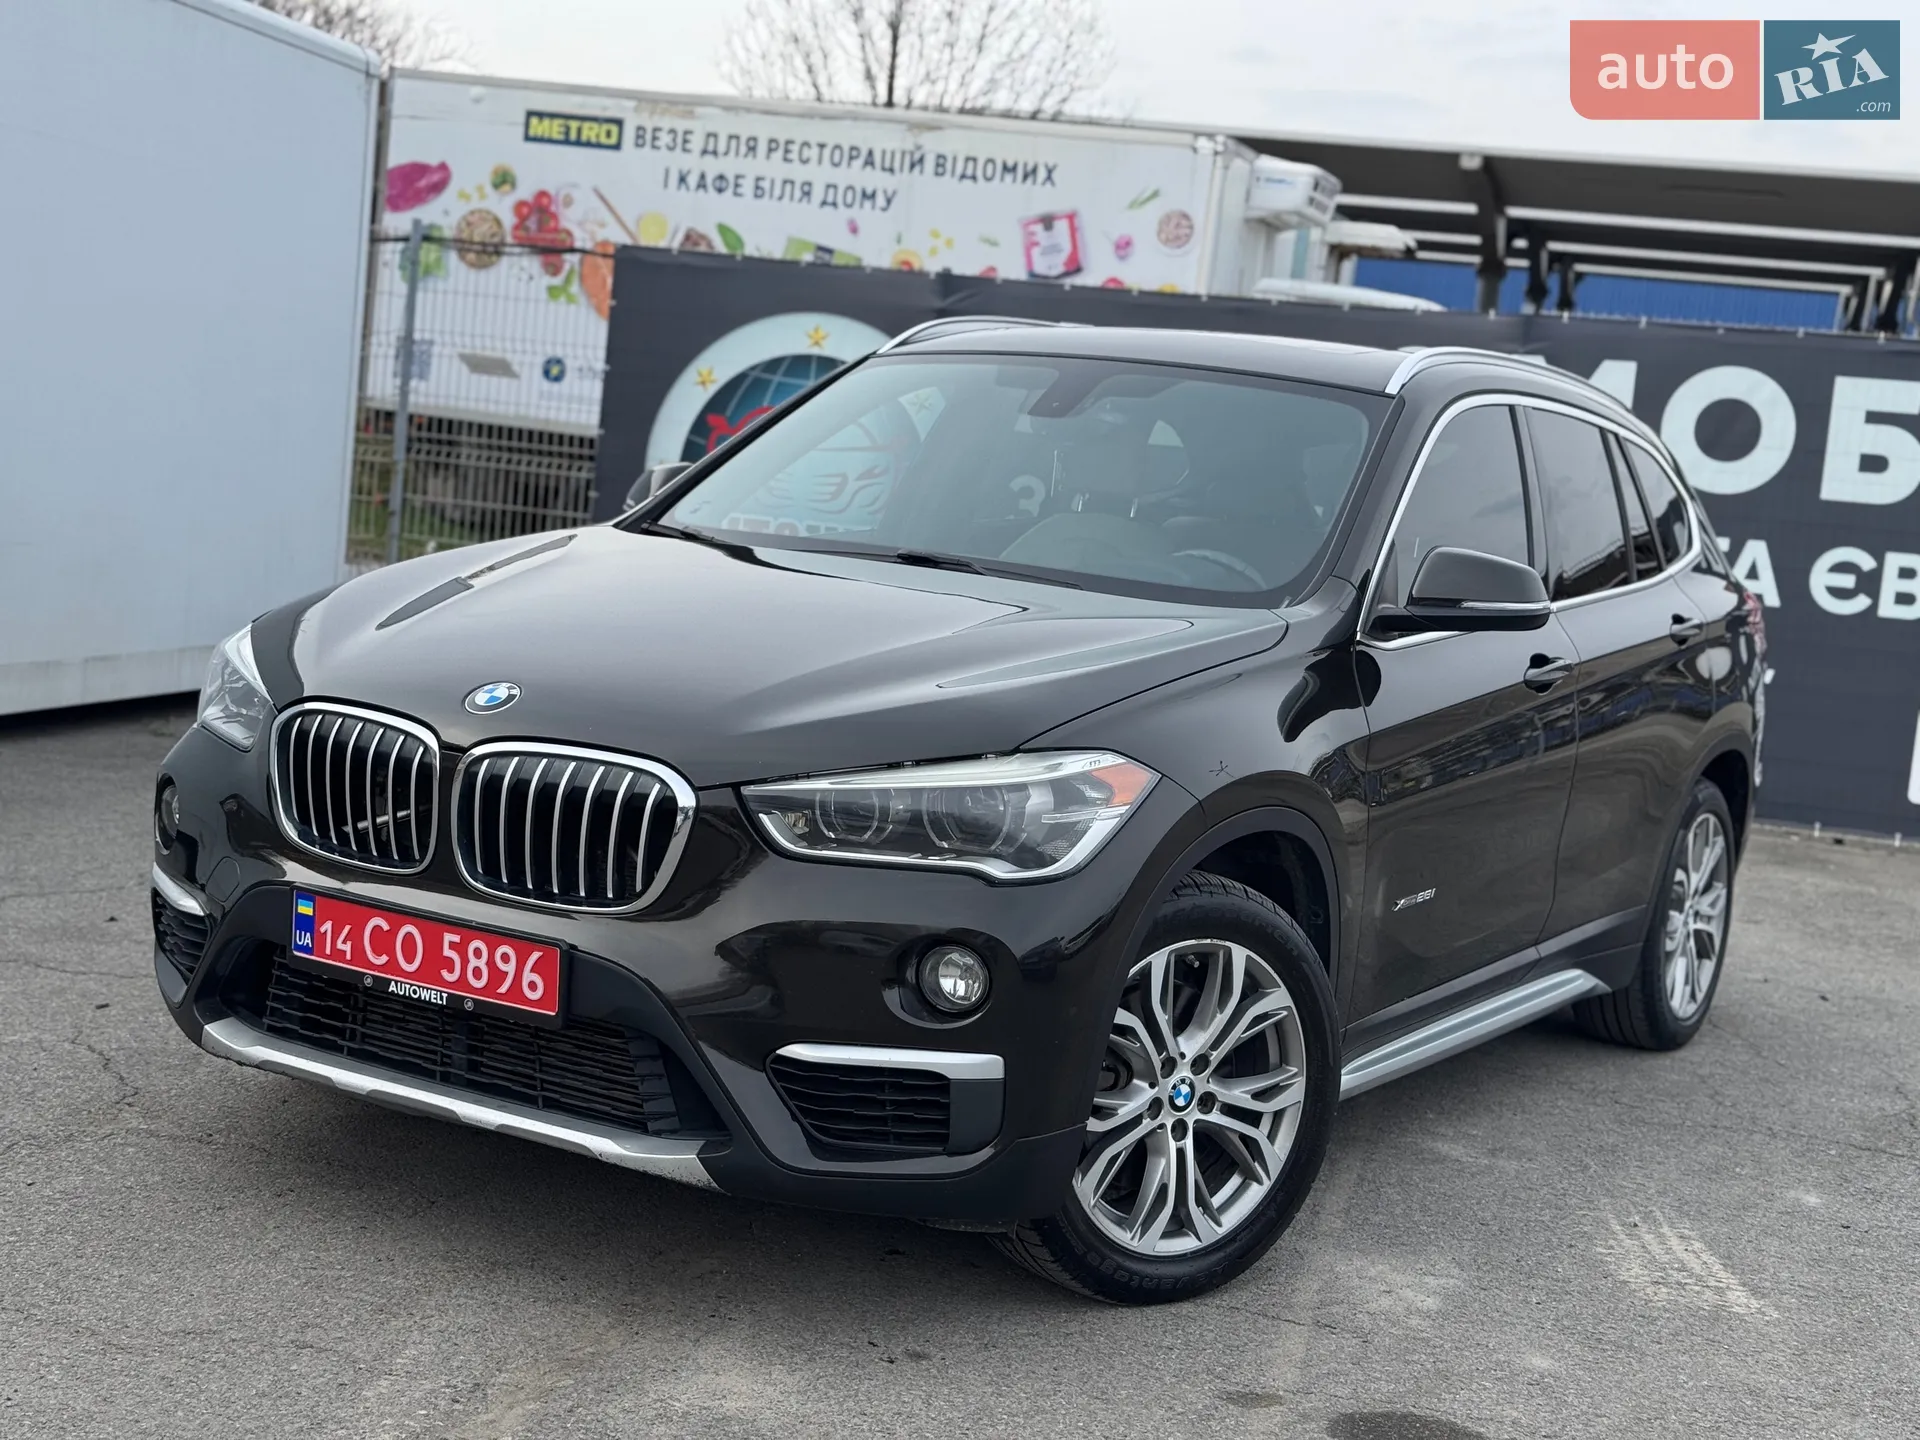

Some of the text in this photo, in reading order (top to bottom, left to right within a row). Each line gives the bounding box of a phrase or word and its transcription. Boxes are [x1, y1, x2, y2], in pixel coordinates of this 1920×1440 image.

[527, 115, 621, 146] METRO
[633, 125, 1059, 187] ВЕЗЕ ДЛЯ РЕСТОРАЦІЙ ВІДОМИХ
[662, 166, 898, 212] І КАФЕ БІЛЯ ДОМУ
[296, 930, 312, 949] UA
[319, 919, 353, 961] 14
[440, 932, 545, 1001] 5896
[388, 980, 448, 1006] AUTOWELT
